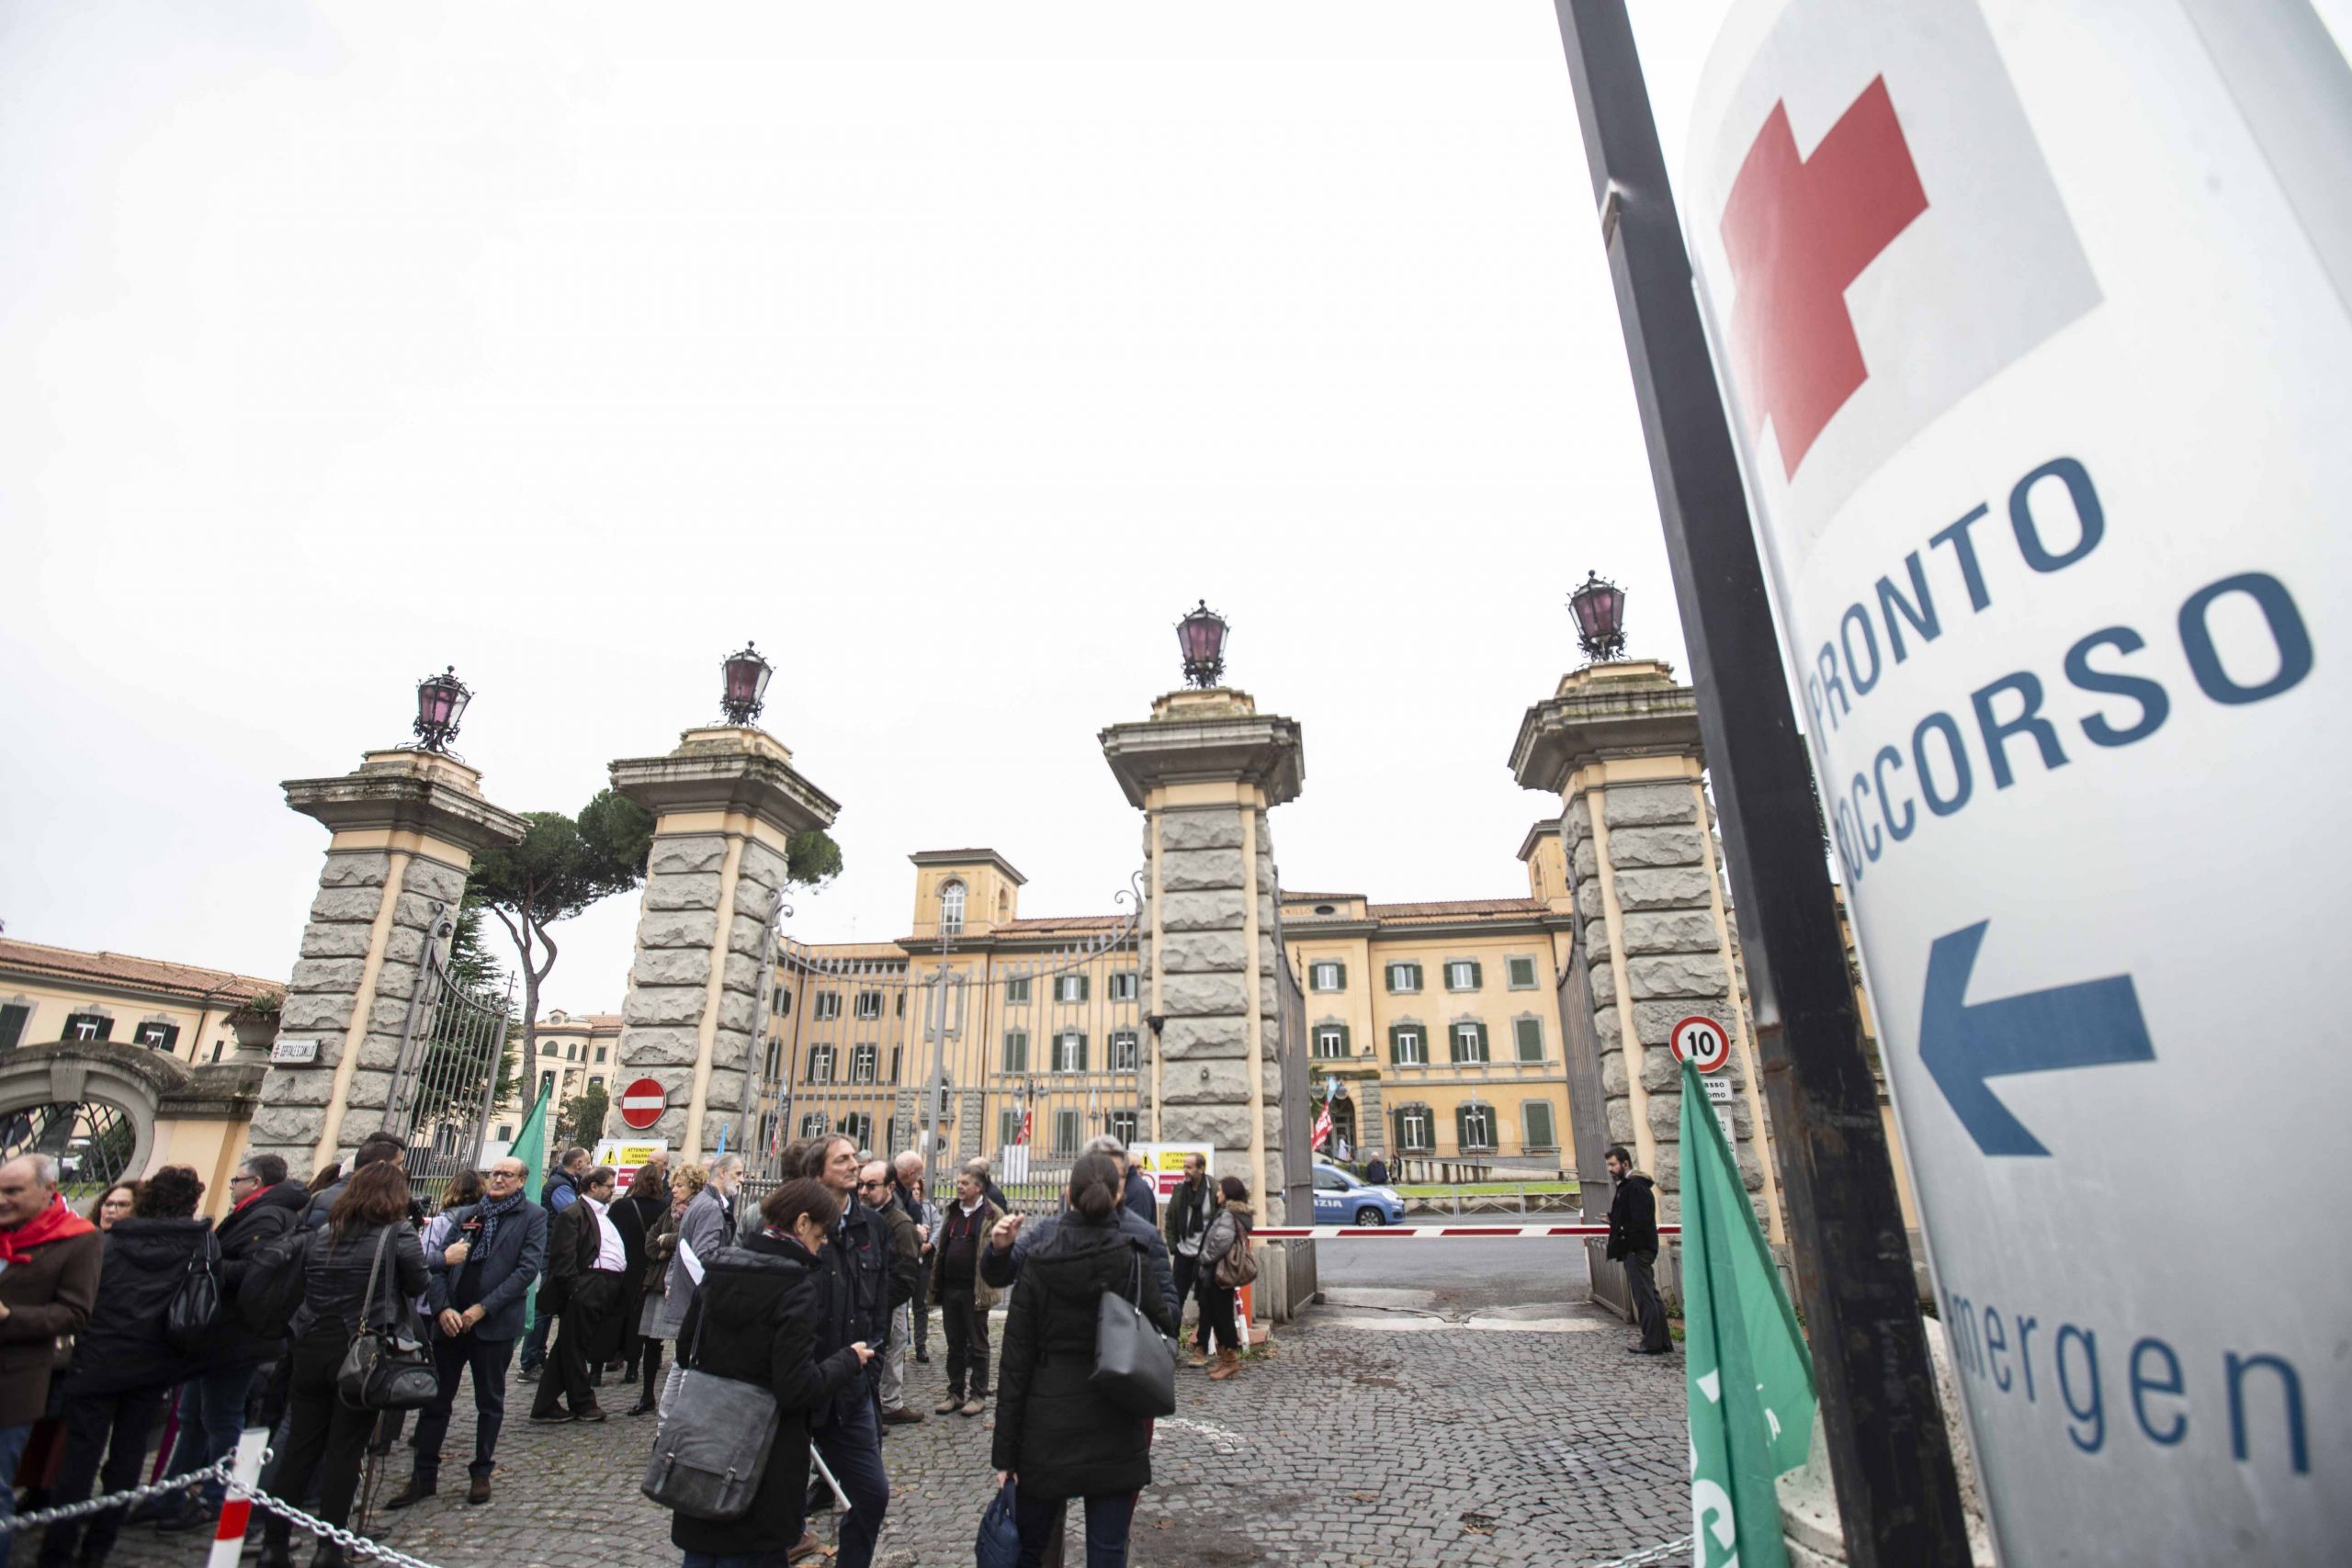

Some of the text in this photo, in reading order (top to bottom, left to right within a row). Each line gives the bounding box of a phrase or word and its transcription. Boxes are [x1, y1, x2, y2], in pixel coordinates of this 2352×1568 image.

[1809, 456, 2106, 754] PRONTO
[1688, 1031, 1715, 1057] 10
[1313, 1199, 1343, 1208] IZIA
[1942, 1288, 2312, 1477] mergen
